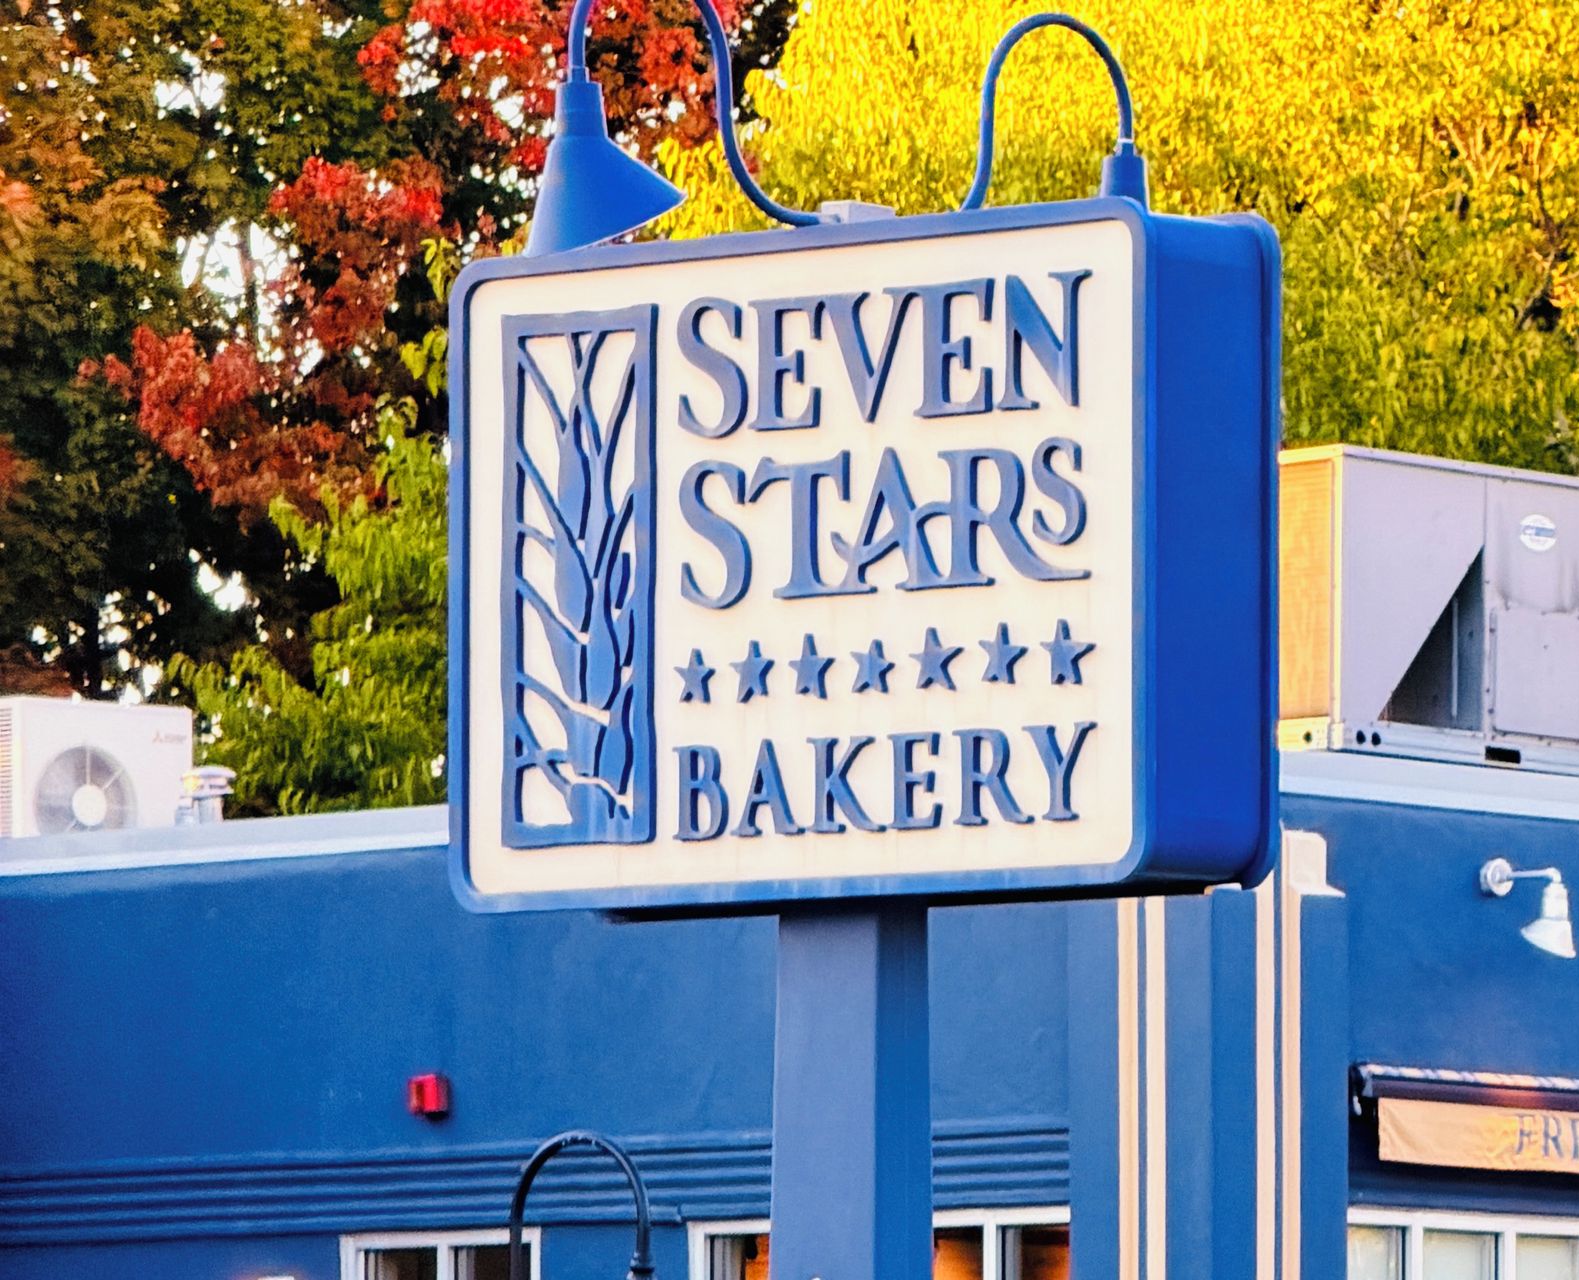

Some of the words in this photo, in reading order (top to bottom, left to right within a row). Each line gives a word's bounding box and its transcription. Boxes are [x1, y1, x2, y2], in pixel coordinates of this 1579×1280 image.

[677, 269, 1094, 439] SEVEN
[678, 436, 1093, 610] STARS
[672, 721, 1097, 843] BAKERY
